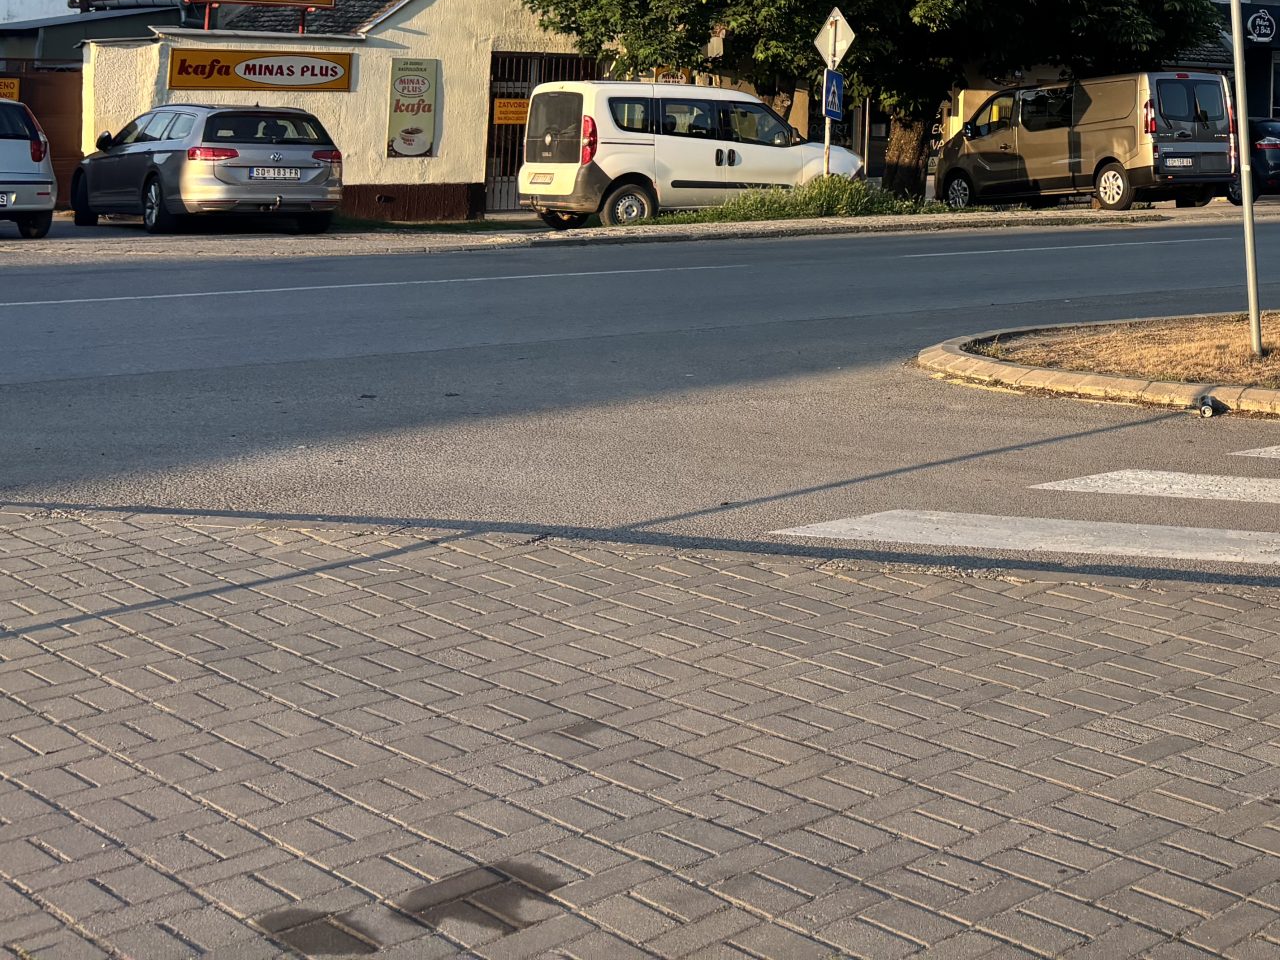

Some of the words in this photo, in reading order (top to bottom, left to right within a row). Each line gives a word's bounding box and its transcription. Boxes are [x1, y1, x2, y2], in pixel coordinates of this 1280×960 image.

[178, 58, 231, 80] kafa
[243, 63, 295, 77] MINAS
[300, 64, 339, 78] PLUS
[398, 78, 426, 86] MINAS
[401, 85, 422, 93] PLUS
[393, 98, 433, 116] kafa
